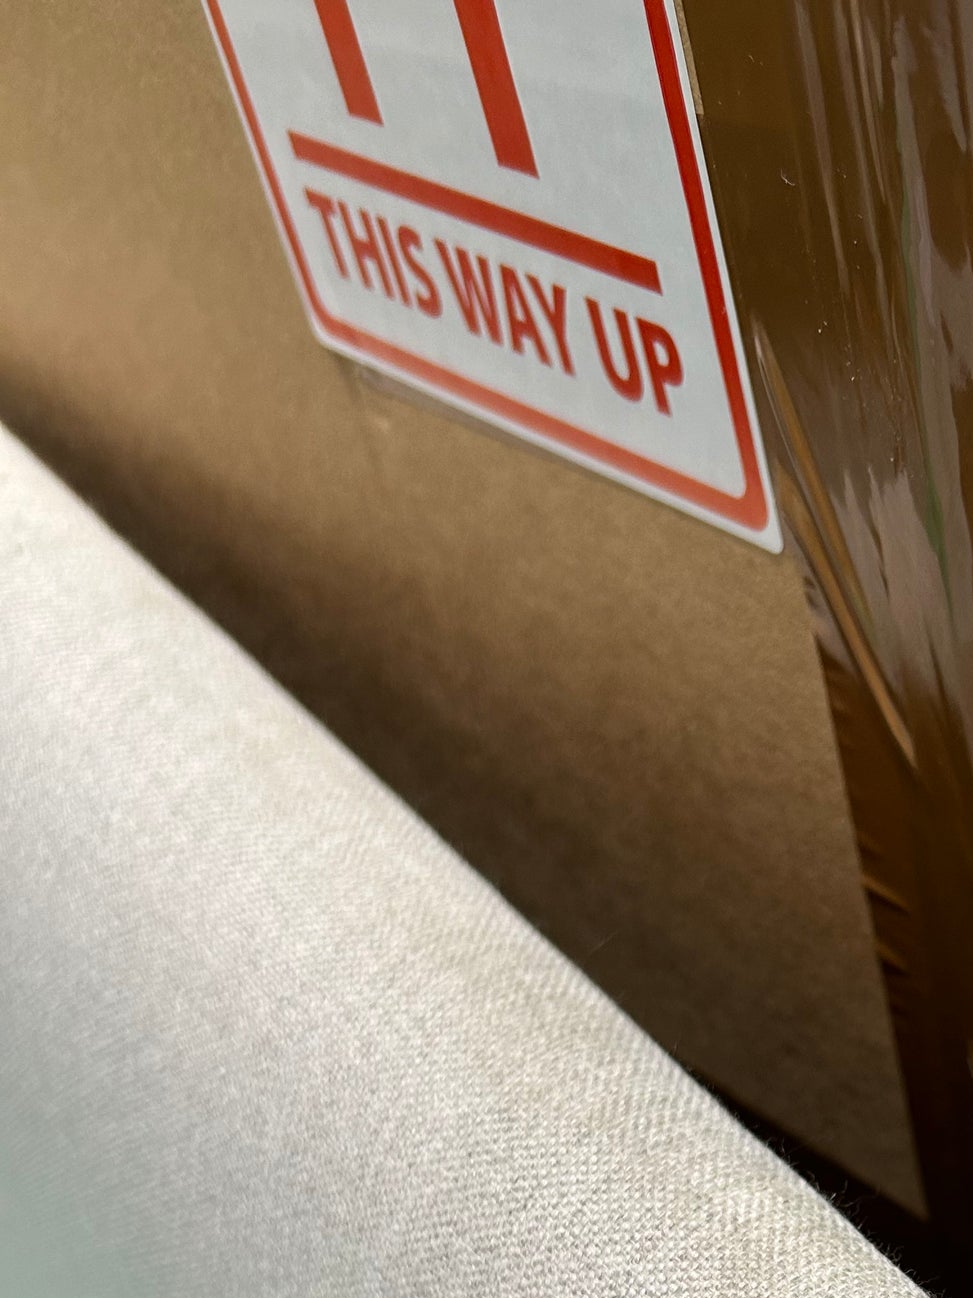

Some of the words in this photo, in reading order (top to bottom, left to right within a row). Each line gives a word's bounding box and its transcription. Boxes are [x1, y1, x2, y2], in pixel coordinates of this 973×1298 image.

[303, 187, 443, 318] THIS
[434, 237, 576, 377] WAY
[585, 296, 684, 416] UP
